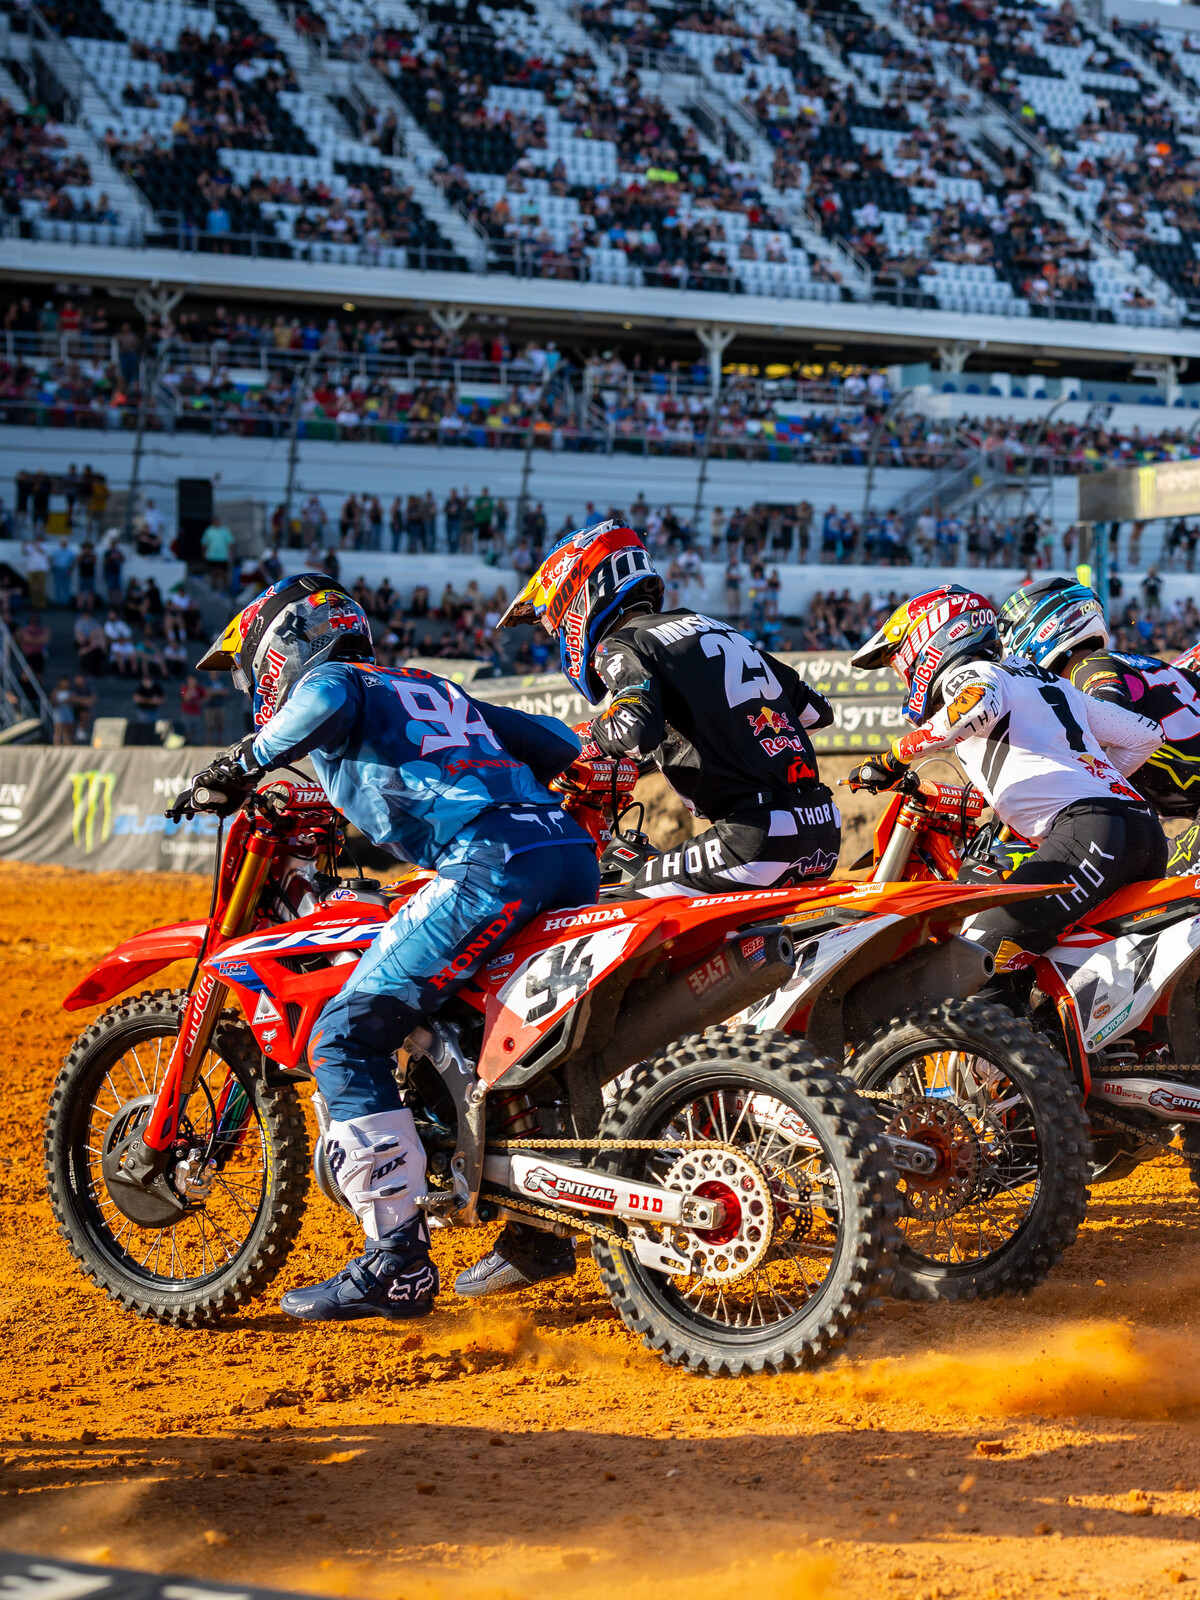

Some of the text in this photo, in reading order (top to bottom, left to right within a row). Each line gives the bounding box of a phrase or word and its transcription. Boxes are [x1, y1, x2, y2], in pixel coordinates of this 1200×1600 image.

[950, 622, 968, 639] BELL
[1039, 621, 1057, 639] BELL
[700, 632, 783, 708] 25
[390, 680, 502, 757] 94
[1038, 684, 1088, 753] 1
[794, 801, 832, 826] THOR
[643, 838, 725, 882] THOR
[543, 908, 627, 932] HONDA
[427, 898, 522, 991] HONDA
[525, 933, 595, 1024] 94
[1101, 1002, 1132, 1037] MOTOREX
[370, 1152, 408, 1184] FOX
[524, 1167, 615, 1202] RENTHAL
